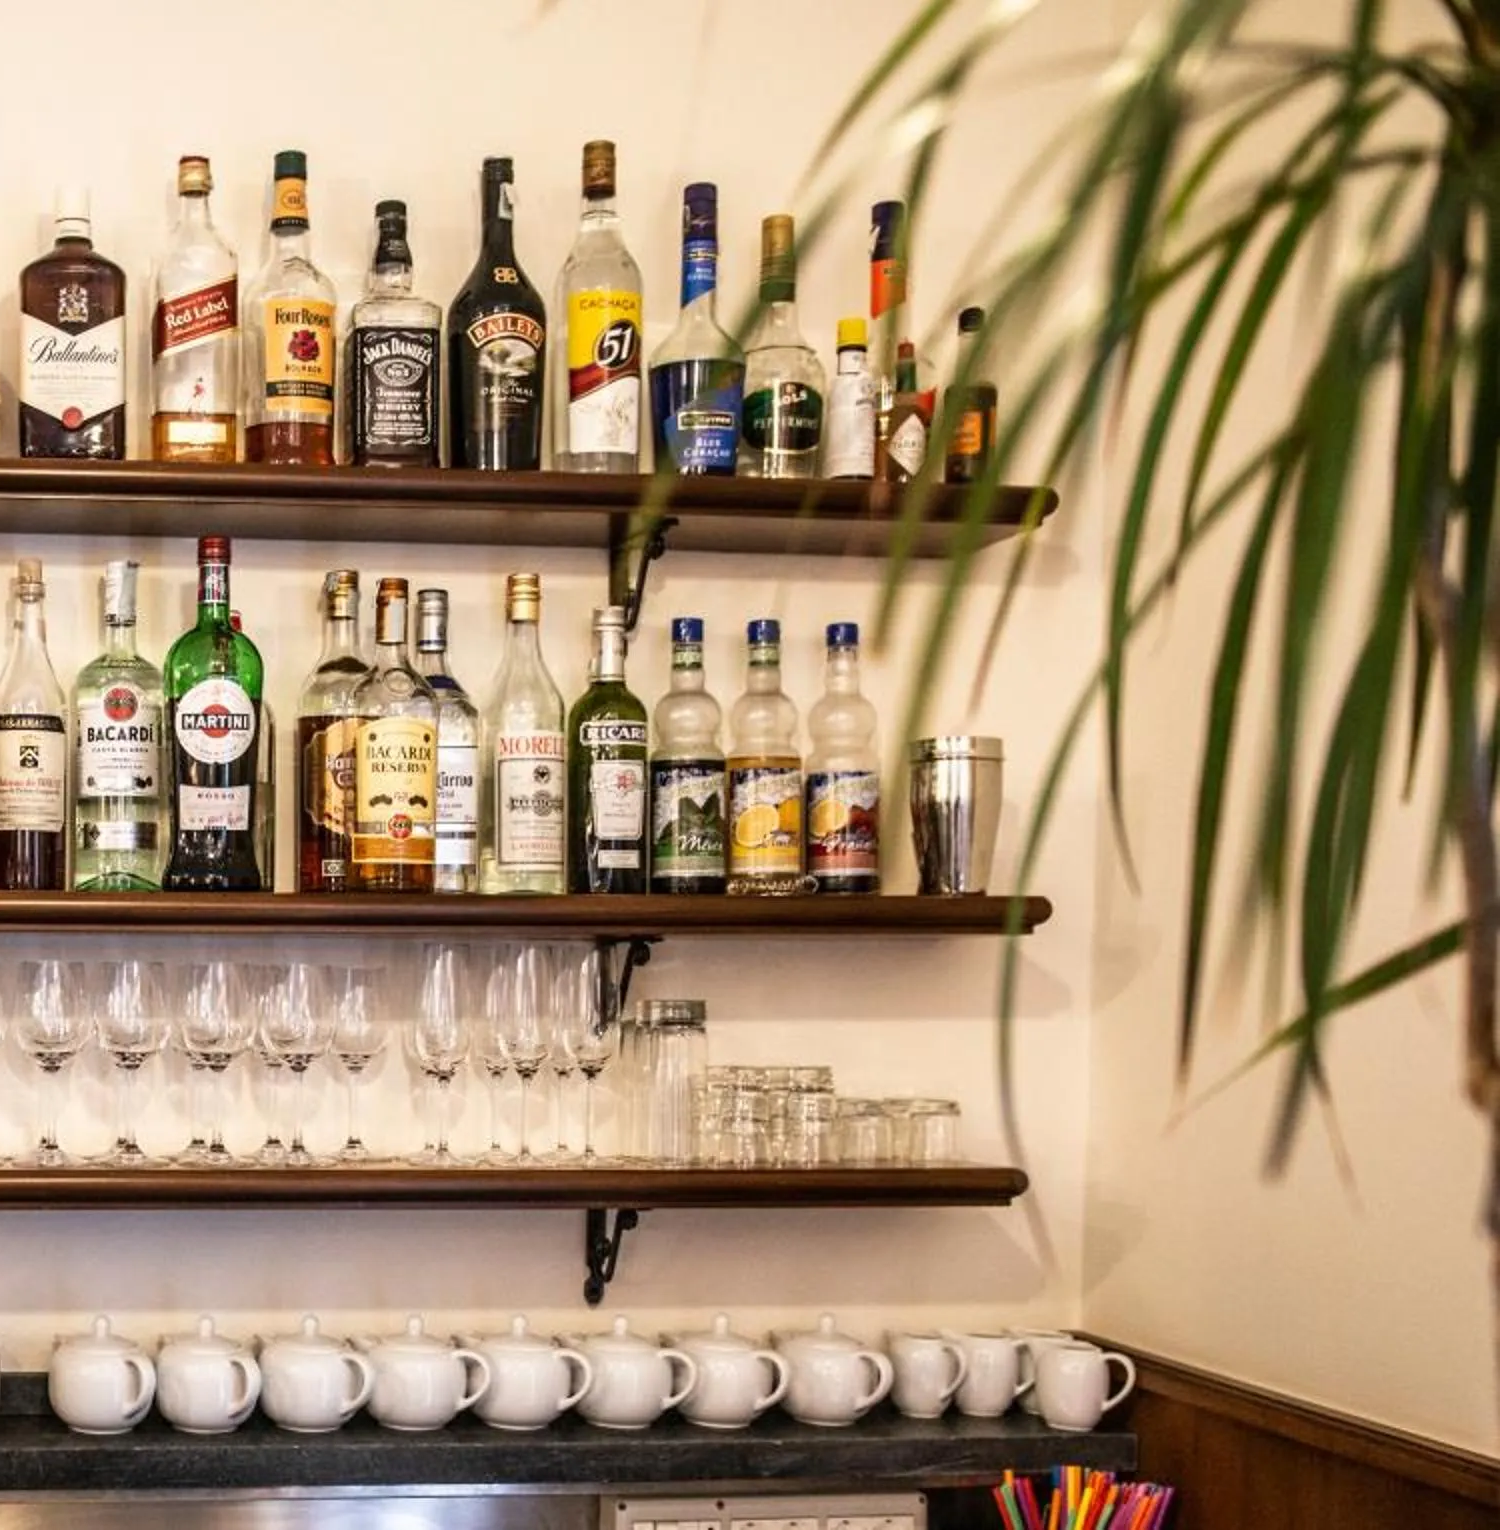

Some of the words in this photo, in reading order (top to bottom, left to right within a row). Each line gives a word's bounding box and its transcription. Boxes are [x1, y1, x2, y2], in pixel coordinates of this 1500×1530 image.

[165, 309, 193, 329] Red
[193, 296, 229, 318] Label
[275, 308, 300, 324] Four
[474, 316, 540, 341] BAILEYS
[28, 335, 119, 364] Ballantine's
[364, 342, 390, 364] JACK
[599, 326, 633, 365] 51
[183, 715, 248, 729] MARTINI
[587, 727, 645, 739] RICAR
[371, 761, 428, 774] RESERVA
